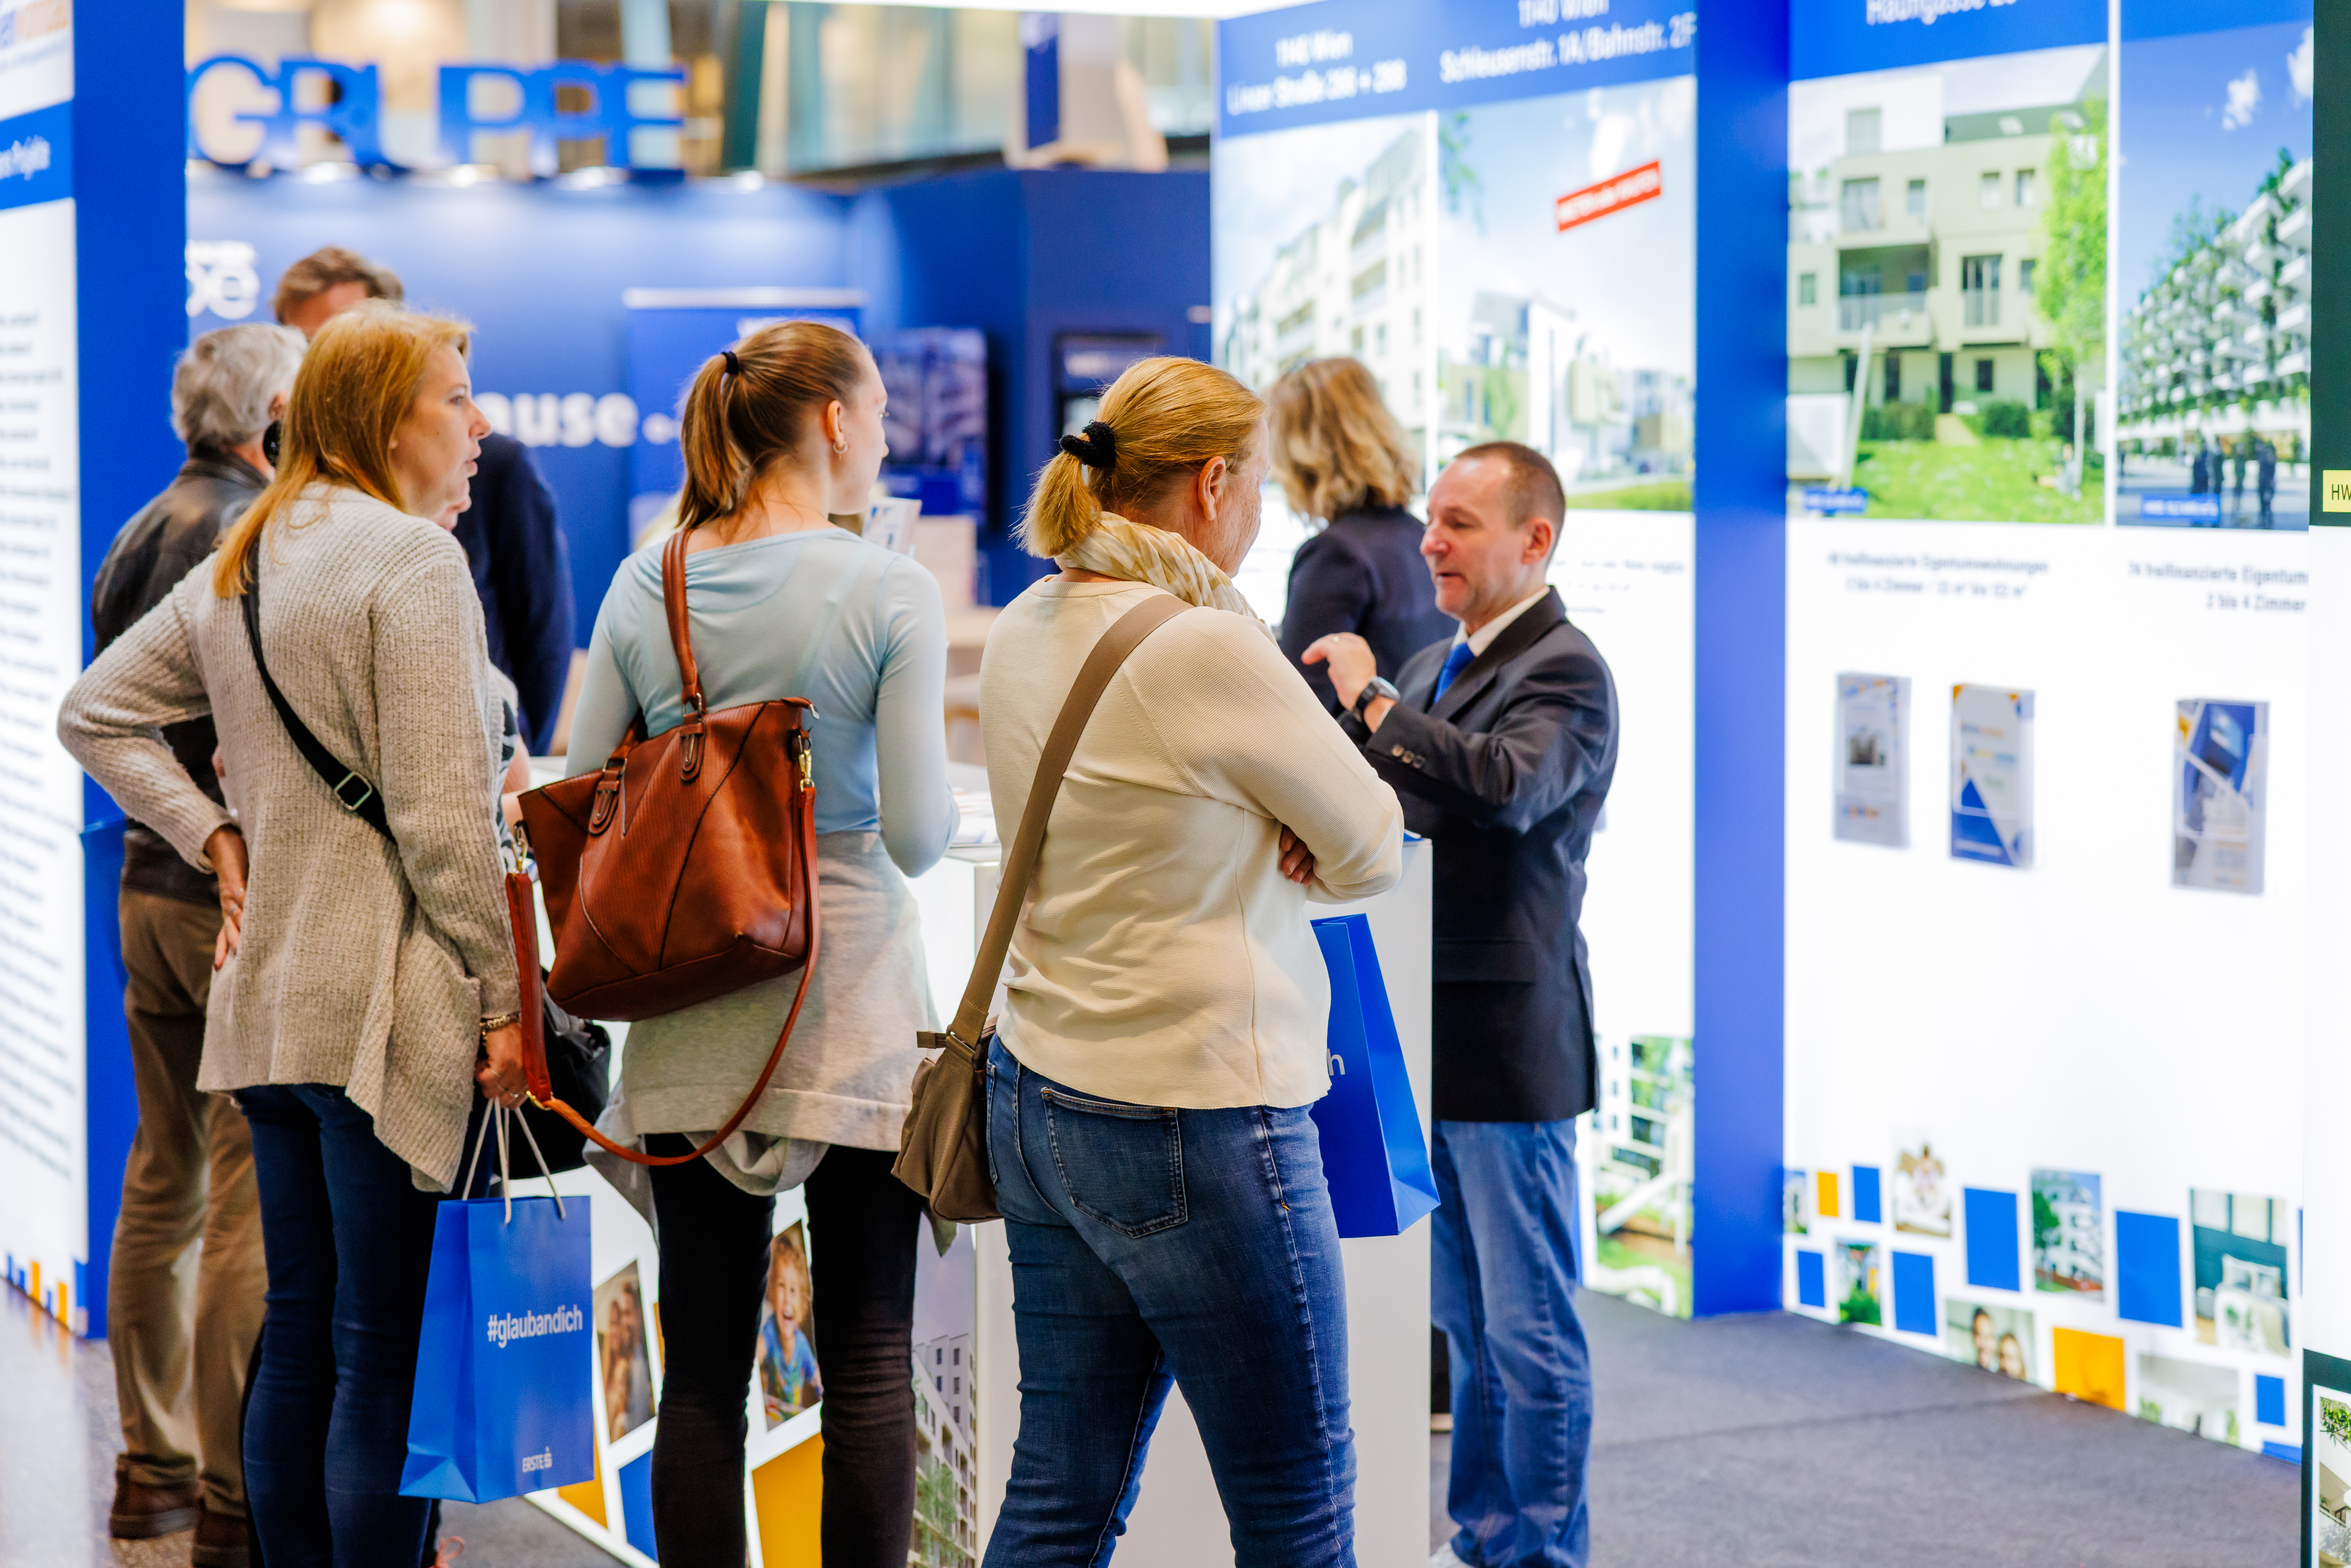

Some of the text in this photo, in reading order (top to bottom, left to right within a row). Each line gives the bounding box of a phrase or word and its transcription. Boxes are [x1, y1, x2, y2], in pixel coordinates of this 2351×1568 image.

[185, 55, 685, 182] GRUPPE
[2254, 593, 2307, 612] Zimmer
[487, 1304, 583, 1348] #glaubandich
